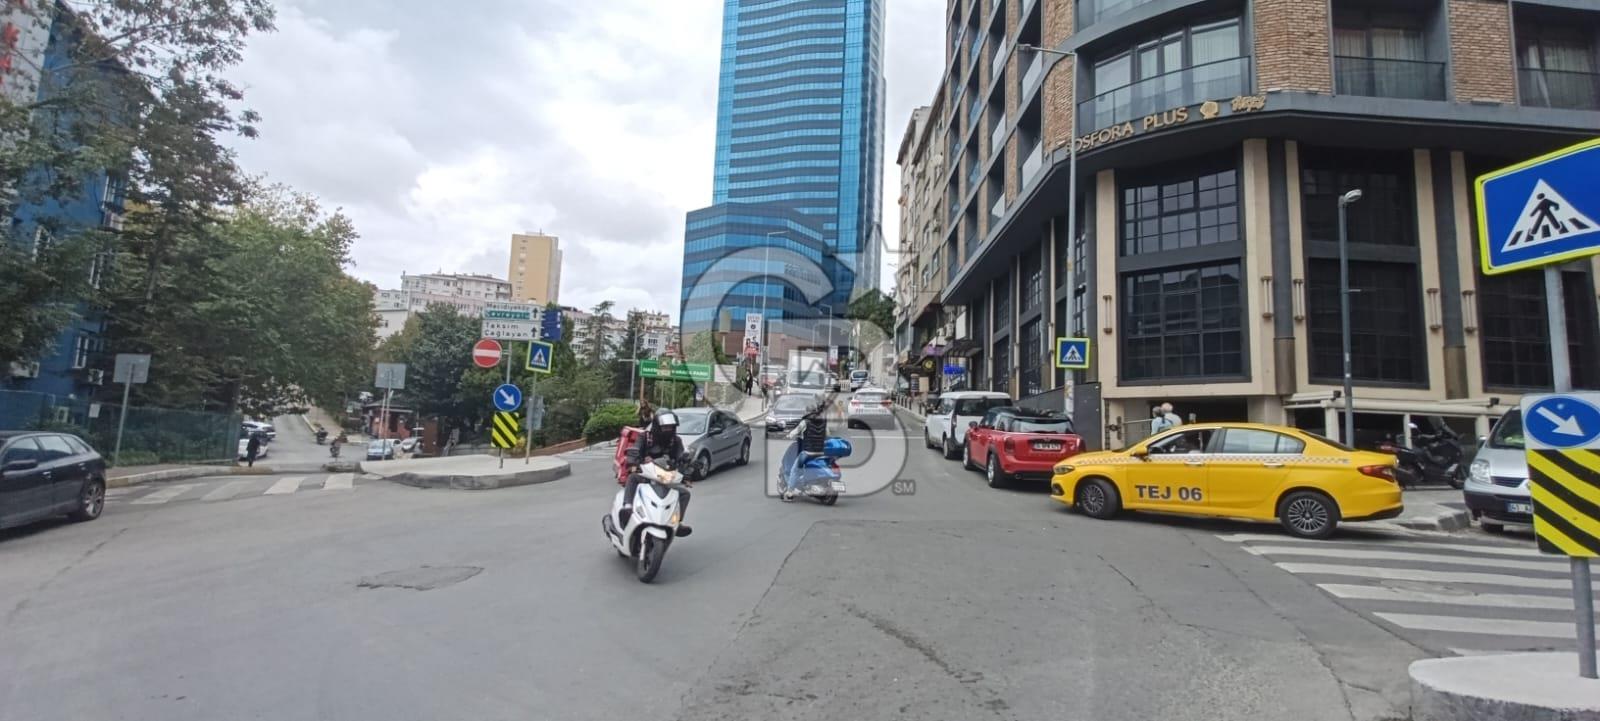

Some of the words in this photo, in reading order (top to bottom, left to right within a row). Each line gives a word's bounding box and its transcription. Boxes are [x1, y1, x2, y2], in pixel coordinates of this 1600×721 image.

[1143, 107, 1188, 131] PLUS
[486, 321, 519, 329] Taksim
[1135, 485, 1171, 500] TEJ
[1178, 486, 1203, 502] 06
